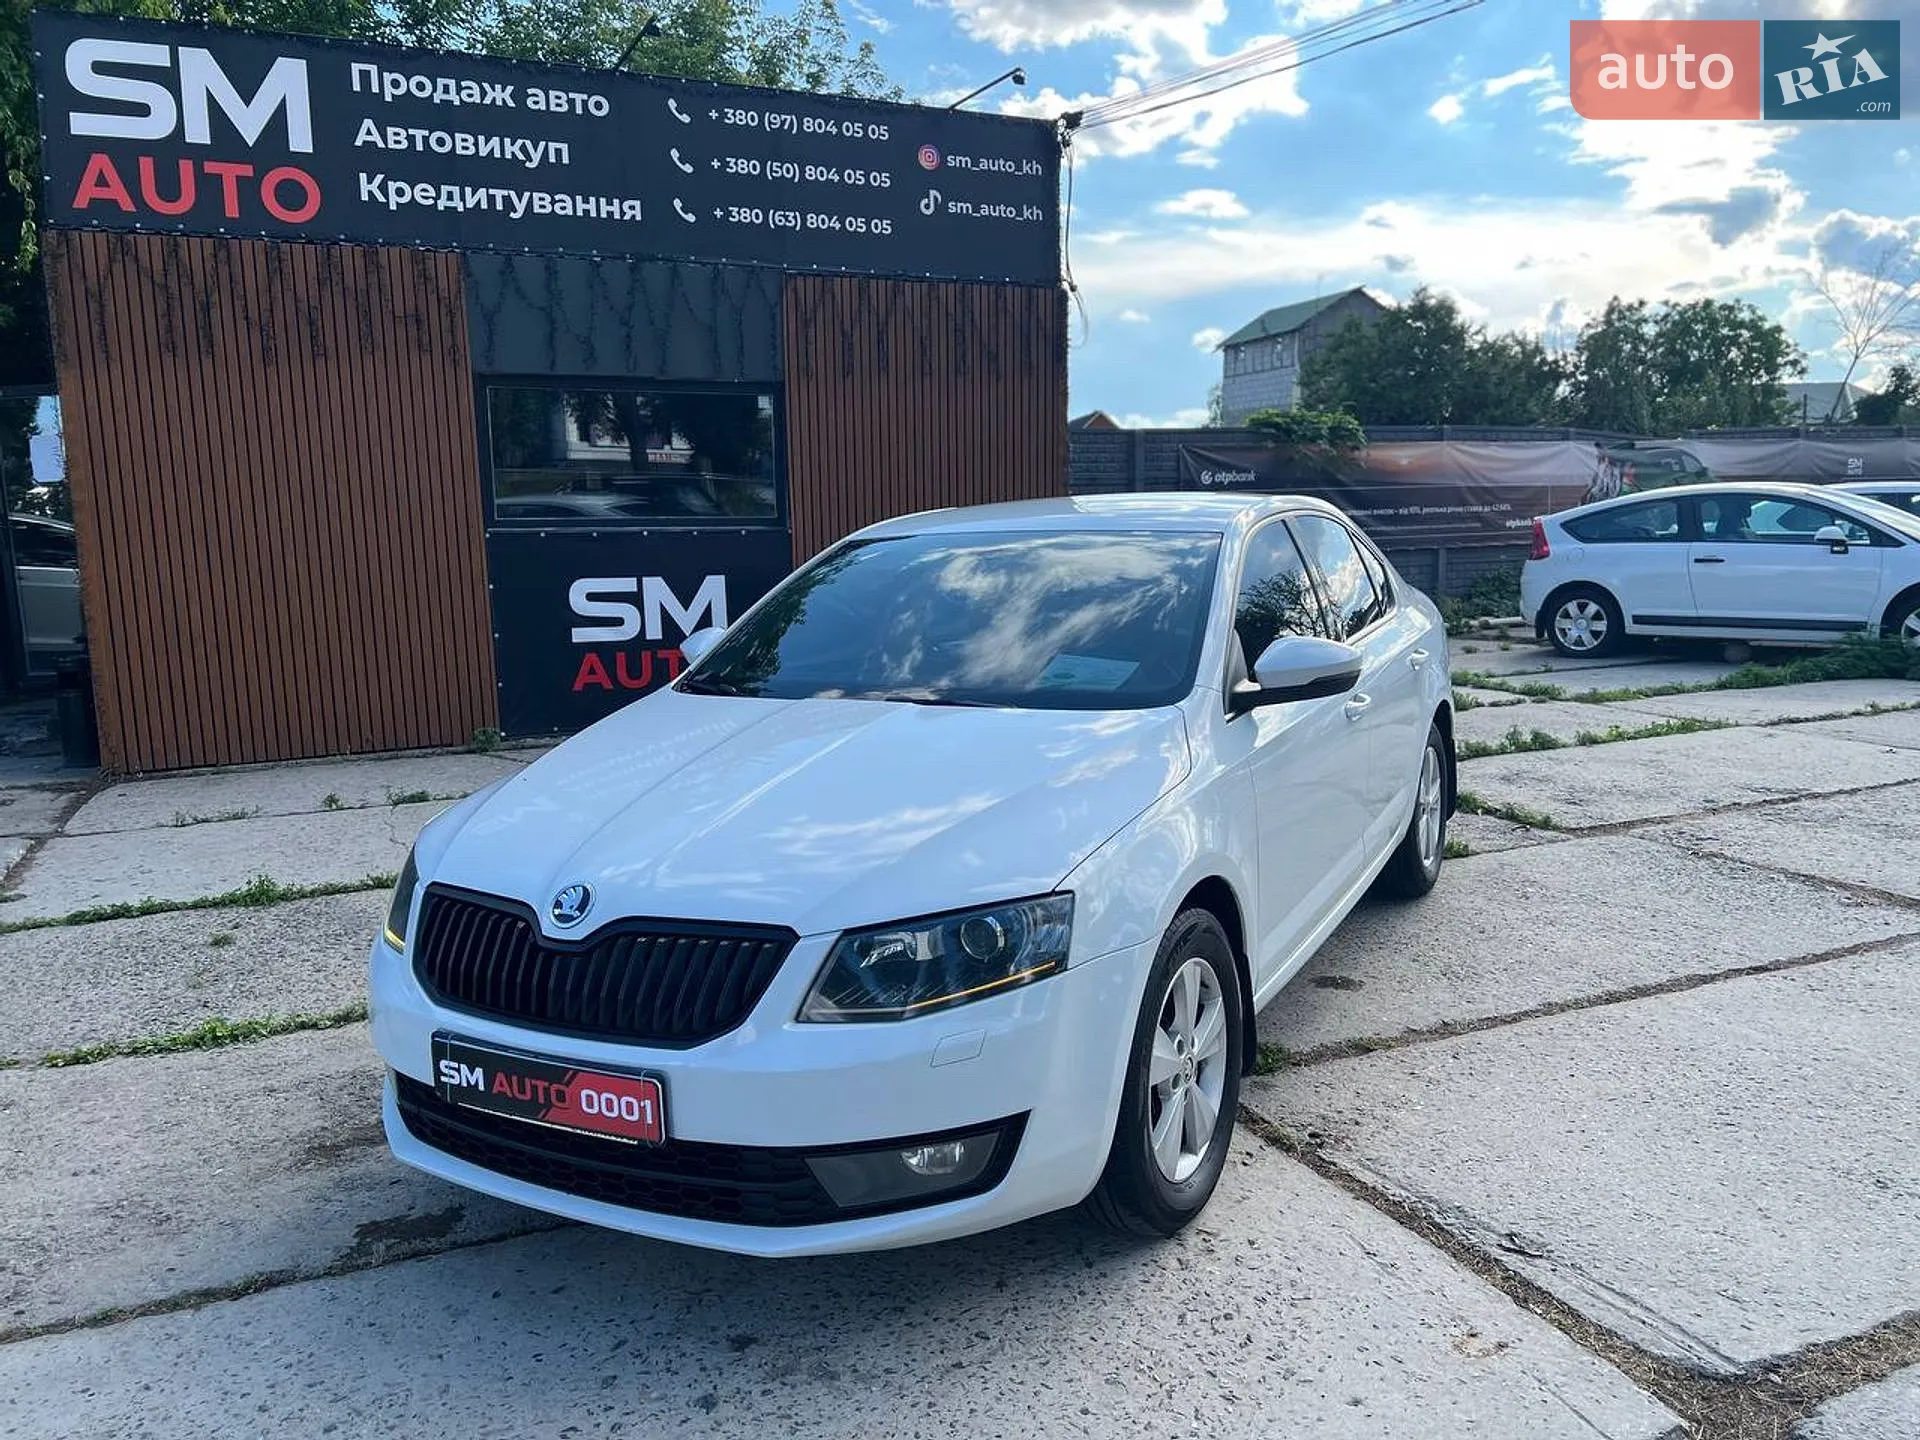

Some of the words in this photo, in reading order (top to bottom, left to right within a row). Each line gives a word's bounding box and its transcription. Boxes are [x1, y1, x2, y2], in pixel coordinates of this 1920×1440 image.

[65, 37, 313, 153] SM
[351, 62, 515, 110] Продаж
[525, 86, 611, 118] авто
[354, 118, 571, 168] Автовикуп
[709, 109, 719, 121] +
[724, 108, 758, 127] 380
[764, 108, 798, 134] (97)
[803, 117, 838, 136] 804
[843, 121, 864, 138] 05
[868, 123, 889, 141] 05
[711, 158, 721, 170] +
[726, 157, 760, 176] 380
[766, 160, 799, 182] (50)
[805, 167, 840, 184] 804
[845, 170, 865, 186] 05
[870, 172, 891, 188] 05
[946, 152, 1043, 177] sm_auto_kh
[73, 153, 321, 223] AUTO
[358, 172, 643, 222] Кредитування
[947, 199, 1043, 222] sm_auto_kh
[713, 207, 723, 219] +
[729, 206, 762, 225] 380
[769, 208, 801, 231] (63)
[807, 216, 841, 231] 804
[846, 219, 867, 233] 05
[871, 220, 892, 235] 05
[1214, 469, 1256, 486] otpbank
[568, 574, 729, 643] SM
[573, 648, 684, 691] AUT
[439, 1058, 485, 1092] SM
[492, 1071, 570, 1107] AUTO
[580, 1088, 653, 1125] 0001
